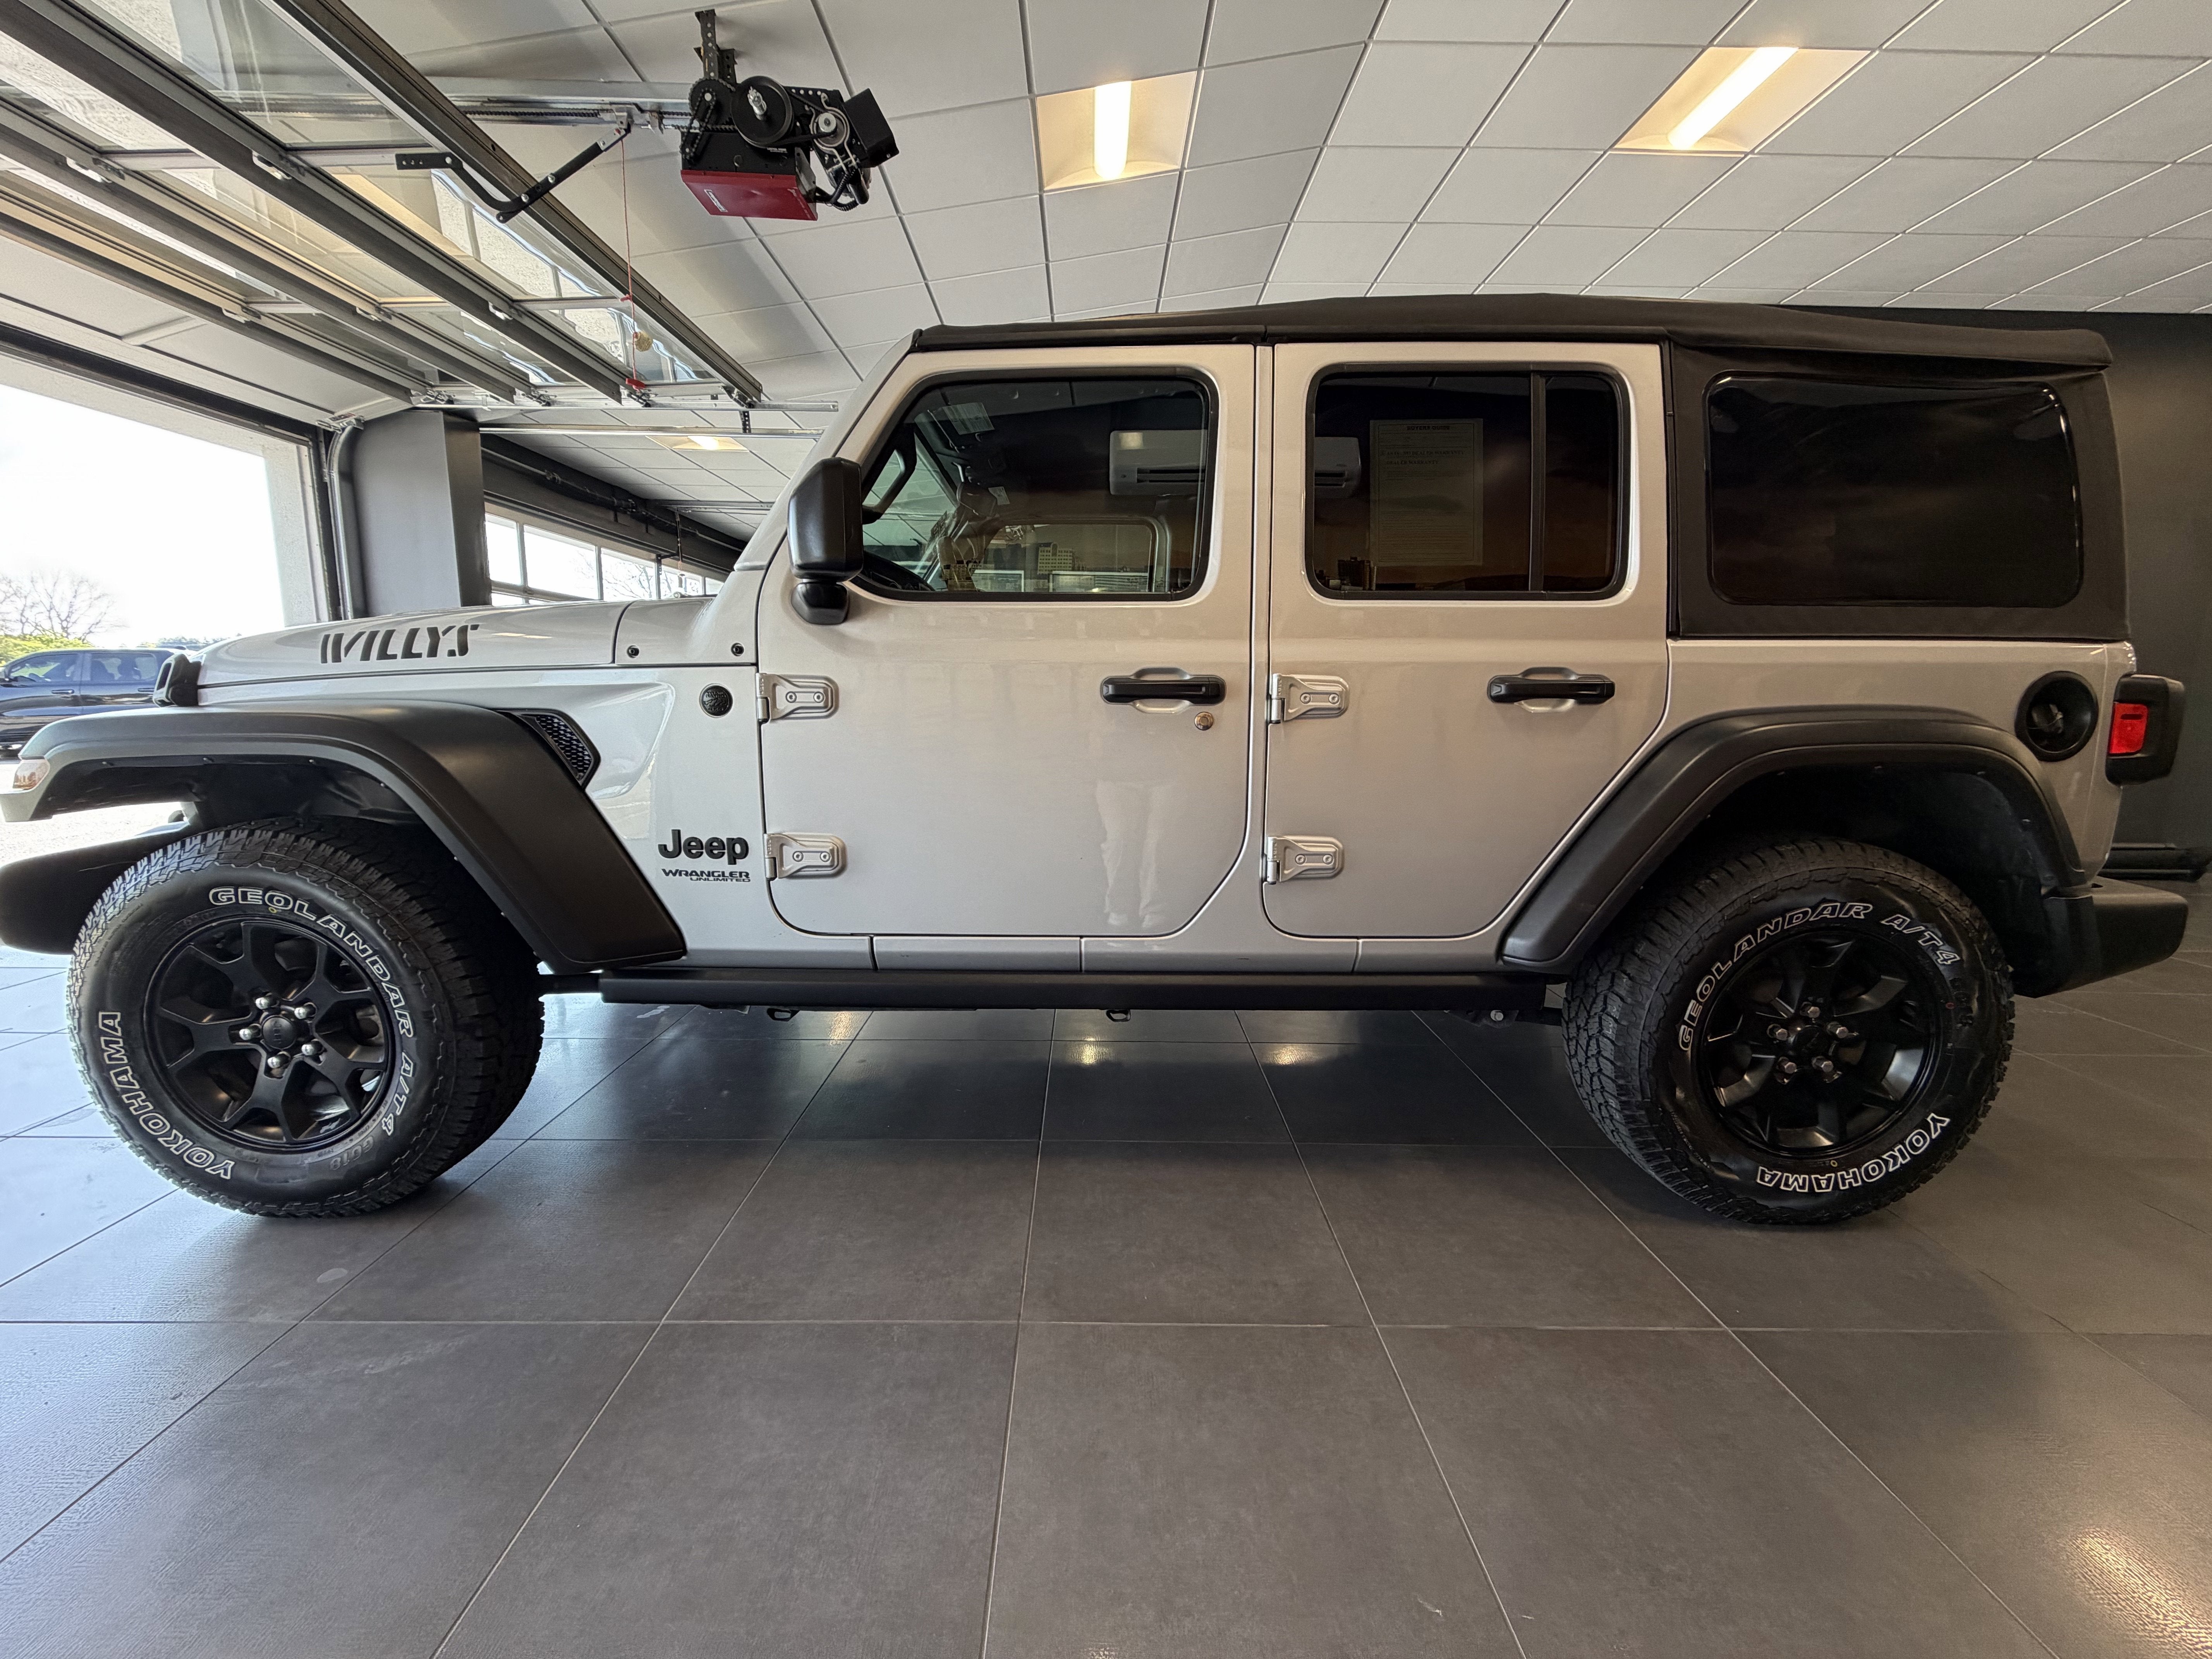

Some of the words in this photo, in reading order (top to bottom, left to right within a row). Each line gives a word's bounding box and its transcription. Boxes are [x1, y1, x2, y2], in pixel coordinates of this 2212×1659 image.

[321, 624, 480, 664] WILLYS
[658, 829, 749, 865] Jeep
[661, 869, 750, 879] WRANGLER
[209, 886, 414, 1038] GEOLANDAR
[1678, 902, 1874, 1052] GEOLANDAR
[98, 1011, 235, 1180] YOKOHAMA
[1755, 1113, 1951, 1193] YOKOHAMA
